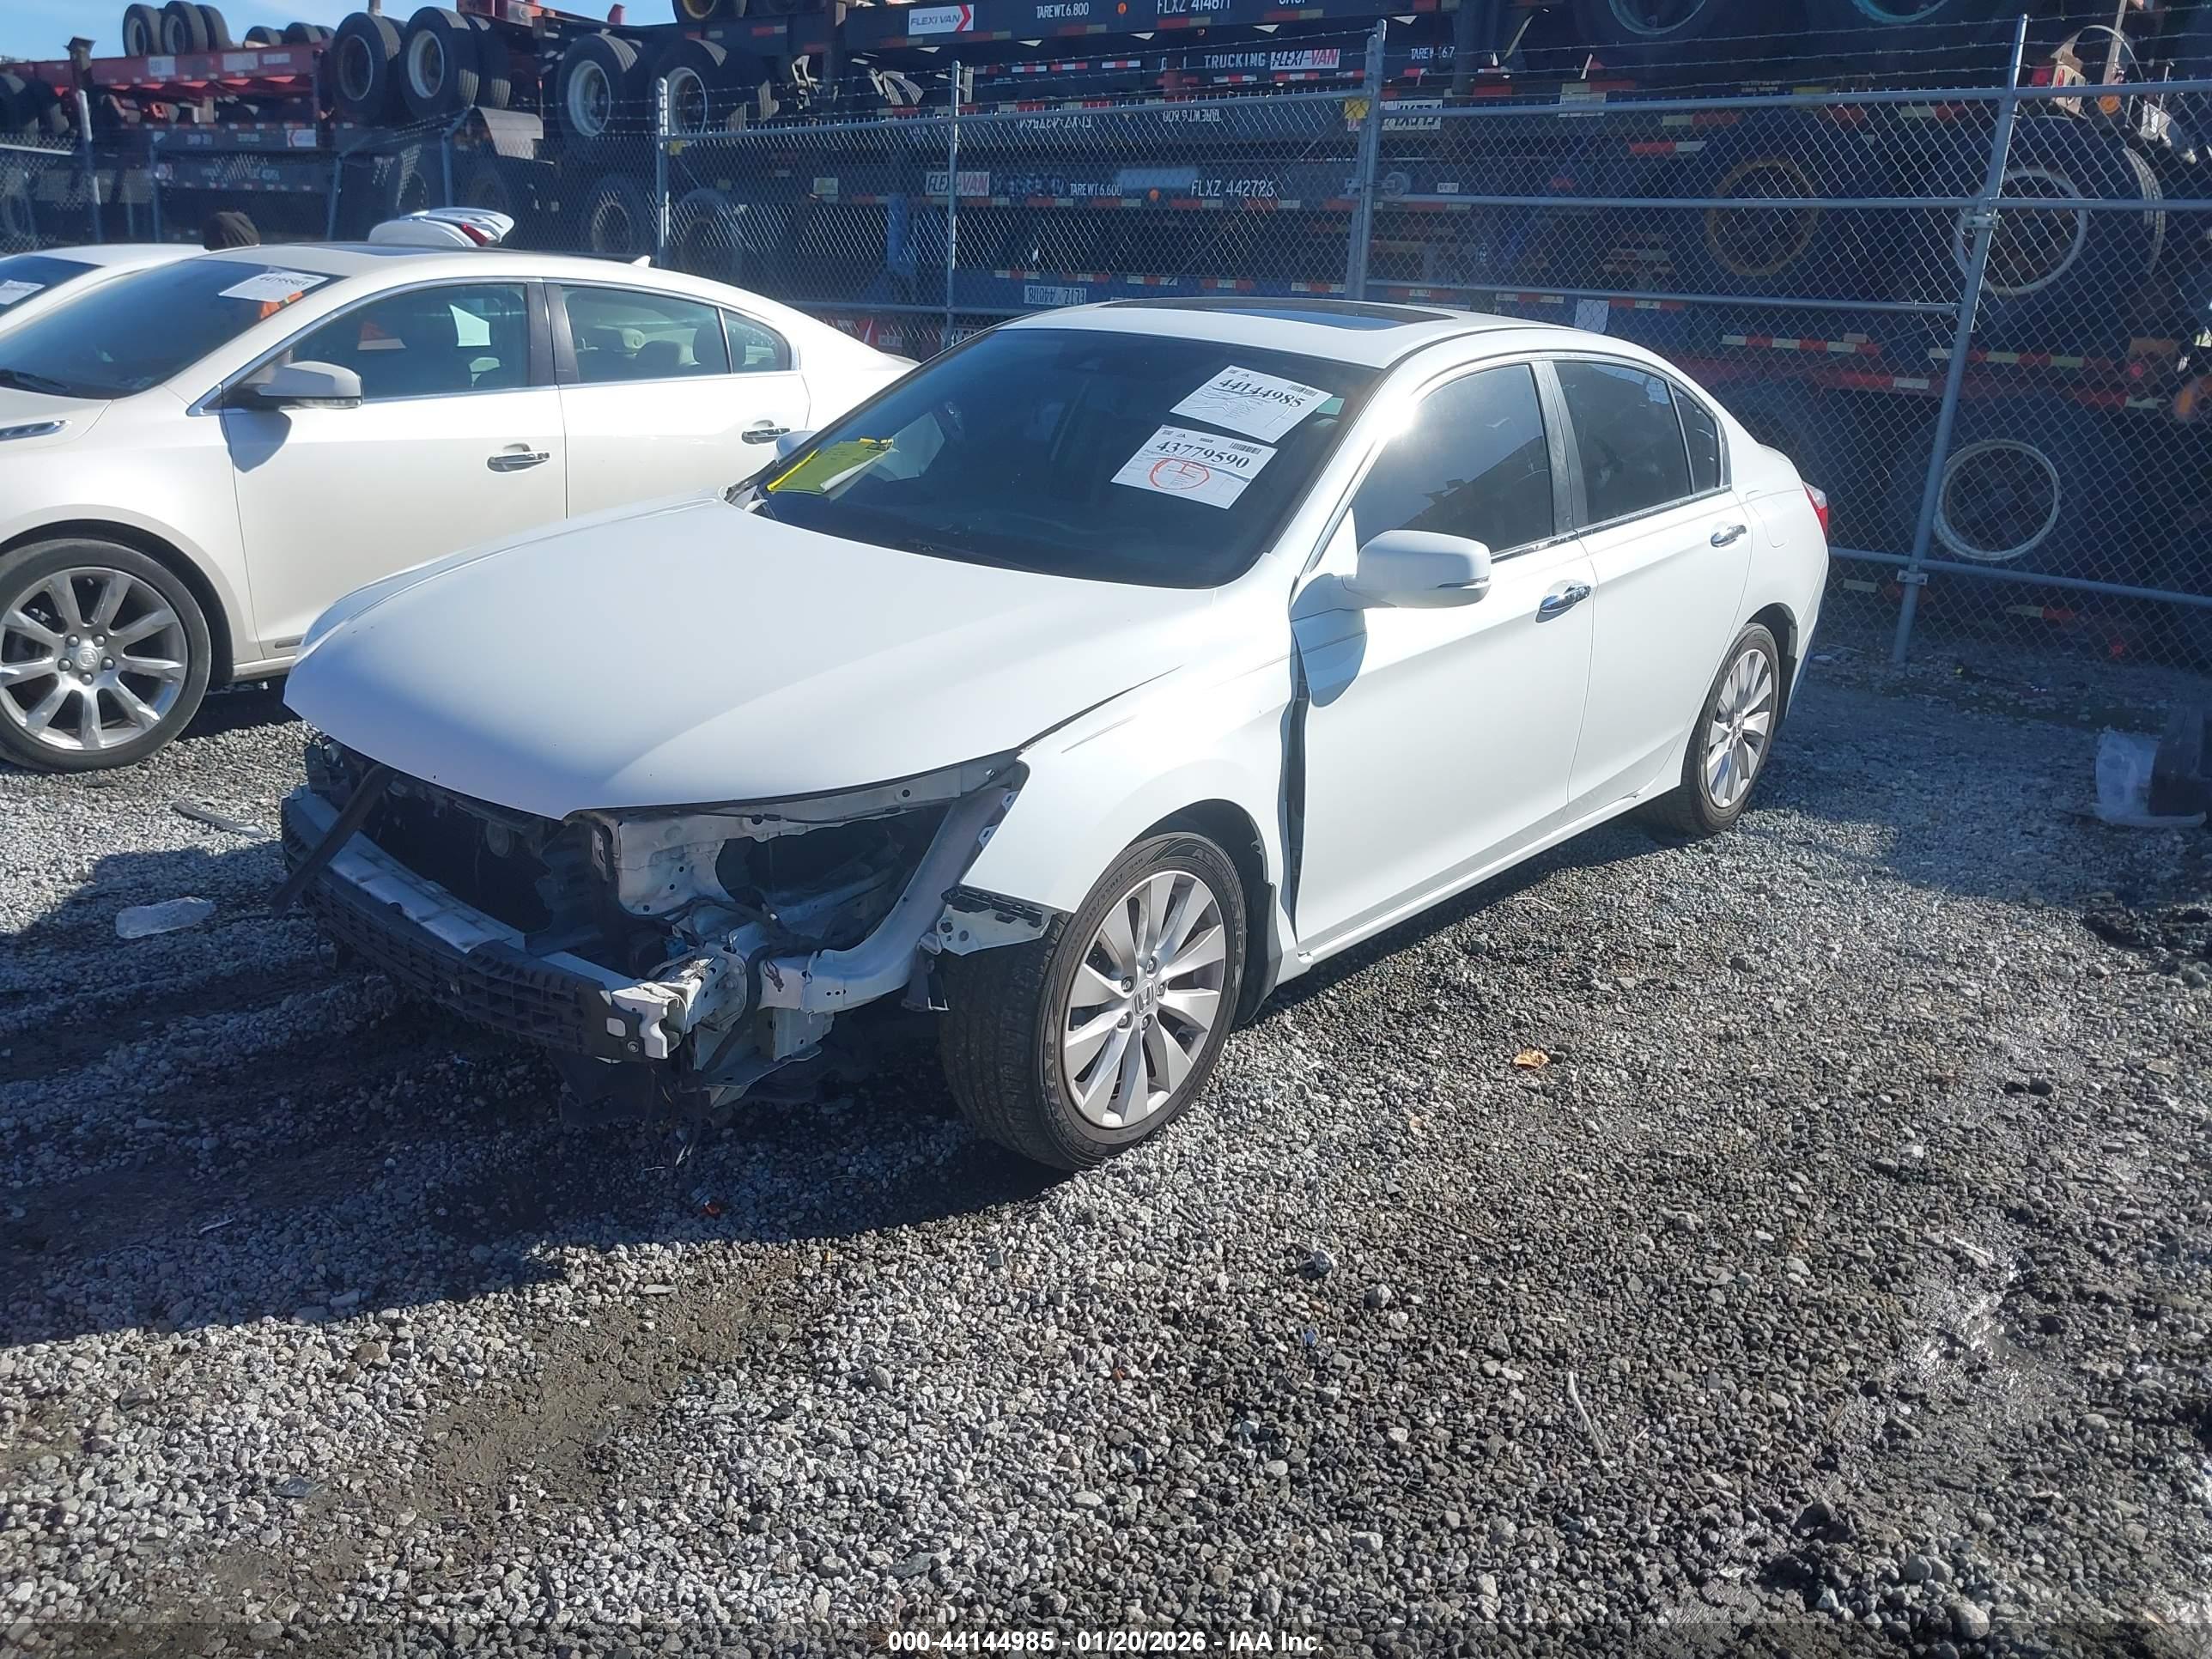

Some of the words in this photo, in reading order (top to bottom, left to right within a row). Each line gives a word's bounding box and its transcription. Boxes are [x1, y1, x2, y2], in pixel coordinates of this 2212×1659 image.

[1204, 52, 1266, 69] TRUCKING
[1190, 179, 1222, 197] FLXZ
[1219, 379, 1306, 408] 44144985
[1157, 441, 1250, 469] 43779590
